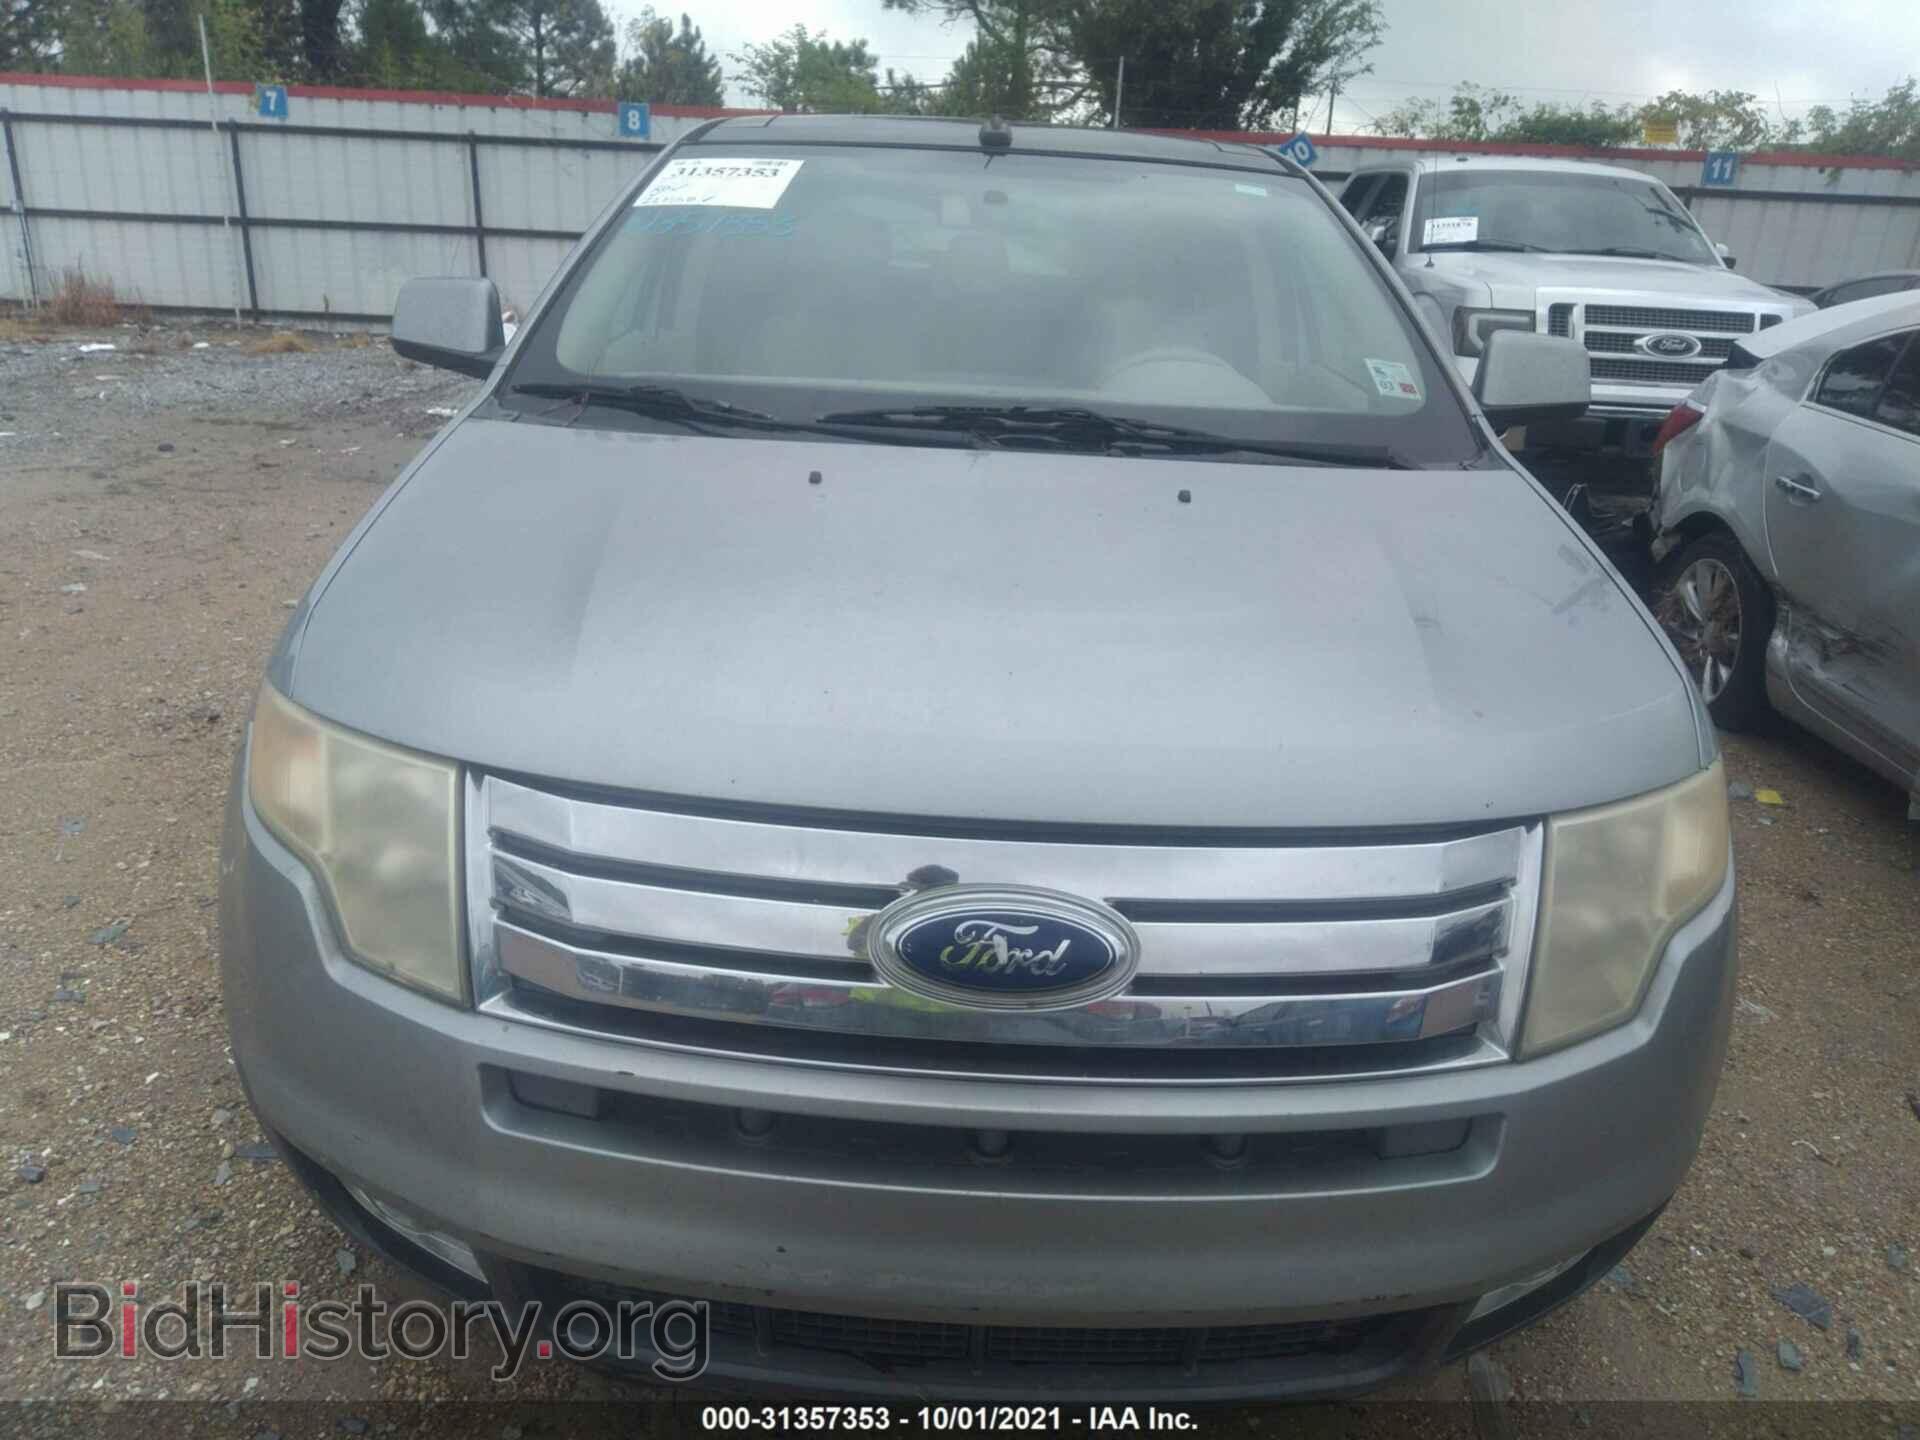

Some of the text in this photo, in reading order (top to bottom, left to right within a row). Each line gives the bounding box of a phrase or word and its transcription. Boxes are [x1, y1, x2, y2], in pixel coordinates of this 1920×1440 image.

[265, 90, 277, 111] 7
[628, 109, 640, 130] 8
[671, 166, 781, 178] 31357353
[1712, 158, 1733, 179] 11
[1660, 339, 1687, 351] Ford
[939, 919, 1071, 966] Ford
